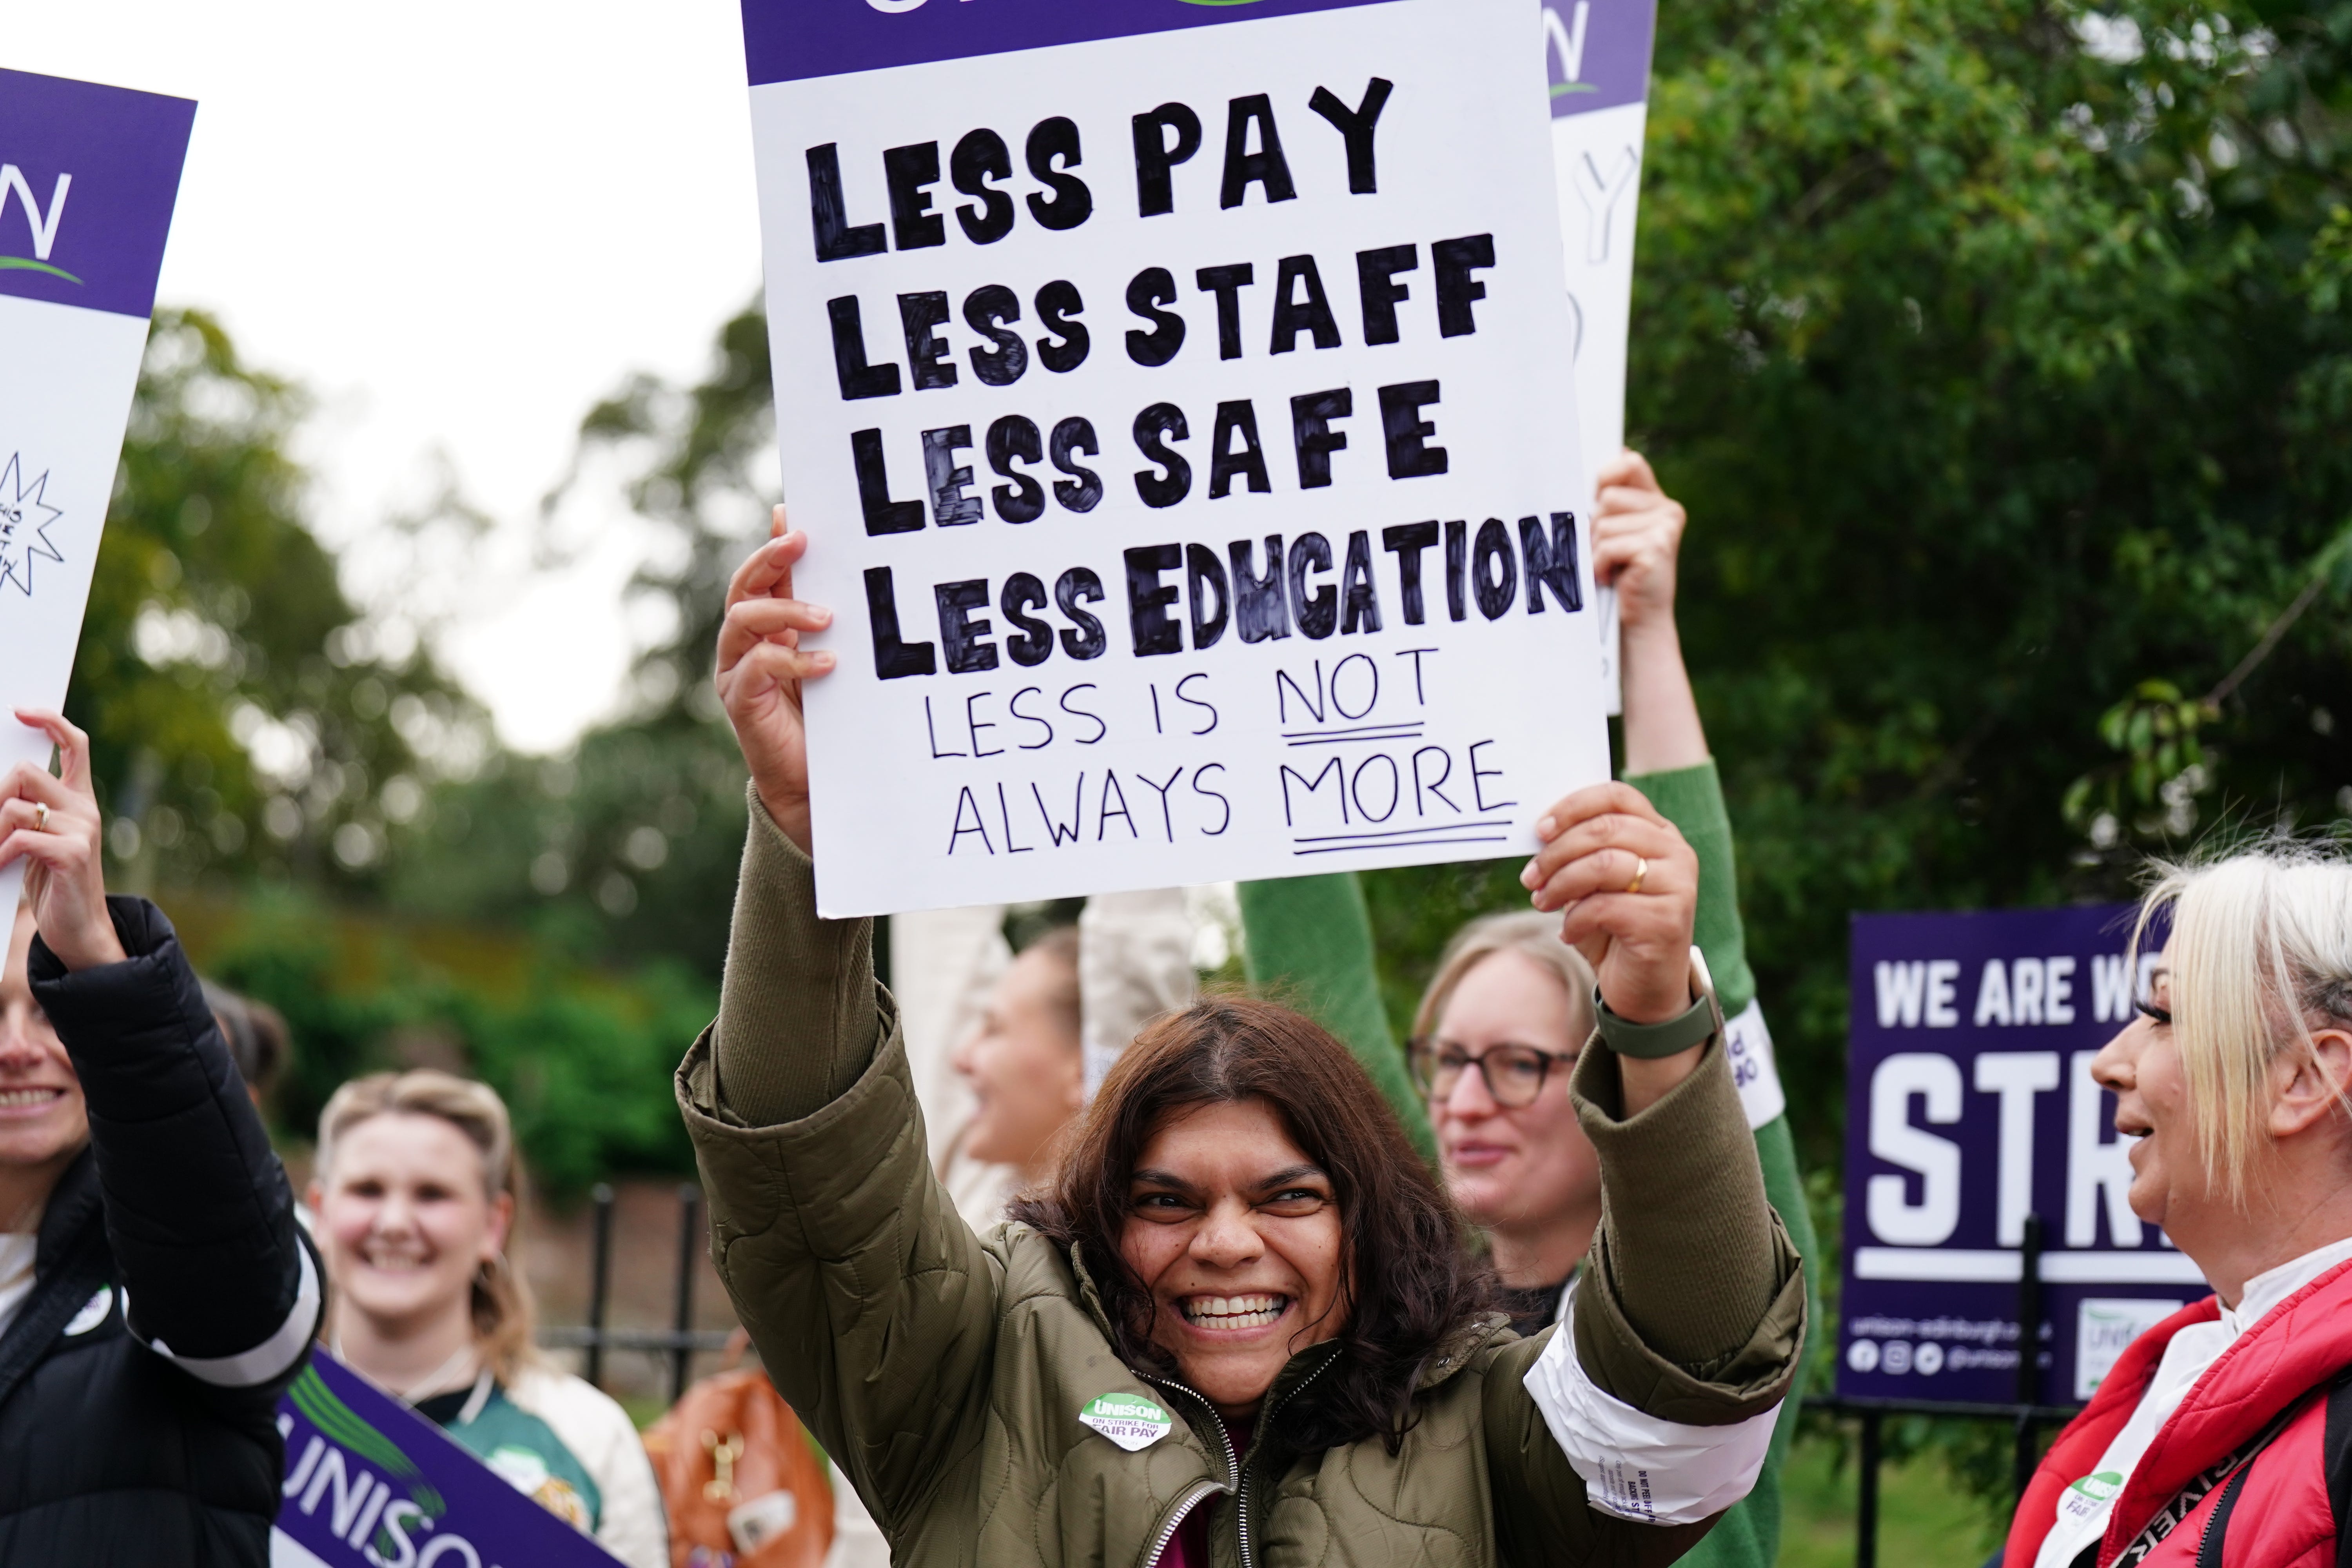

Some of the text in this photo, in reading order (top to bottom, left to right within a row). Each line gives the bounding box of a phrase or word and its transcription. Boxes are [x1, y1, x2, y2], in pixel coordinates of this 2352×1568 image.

[805, 77, 1394, 263] LESS PAY
[827, 280, 1090, 401] LESS
[1125, 233, 1495, 367] STAFF
[851, 379, 1448, 537] LESS SAFE
[863, 512, 1583, 681] LESS EDUCATION
[926, 648, 1439, 759] LESS IS NOT
[948, 740, 1517, 855] ALWAYS MORE
[1873, 960, 1959, 1028] WE
[1973, 955, 2077, 1027] ARE
[1866, 1051, 2177, 1248] STR
[1094, 1399, 1161, 1421] UNISON
[1131, 1427, 1158, 1437] PAY
[1142, 1421, 1159, 1429] FOR
